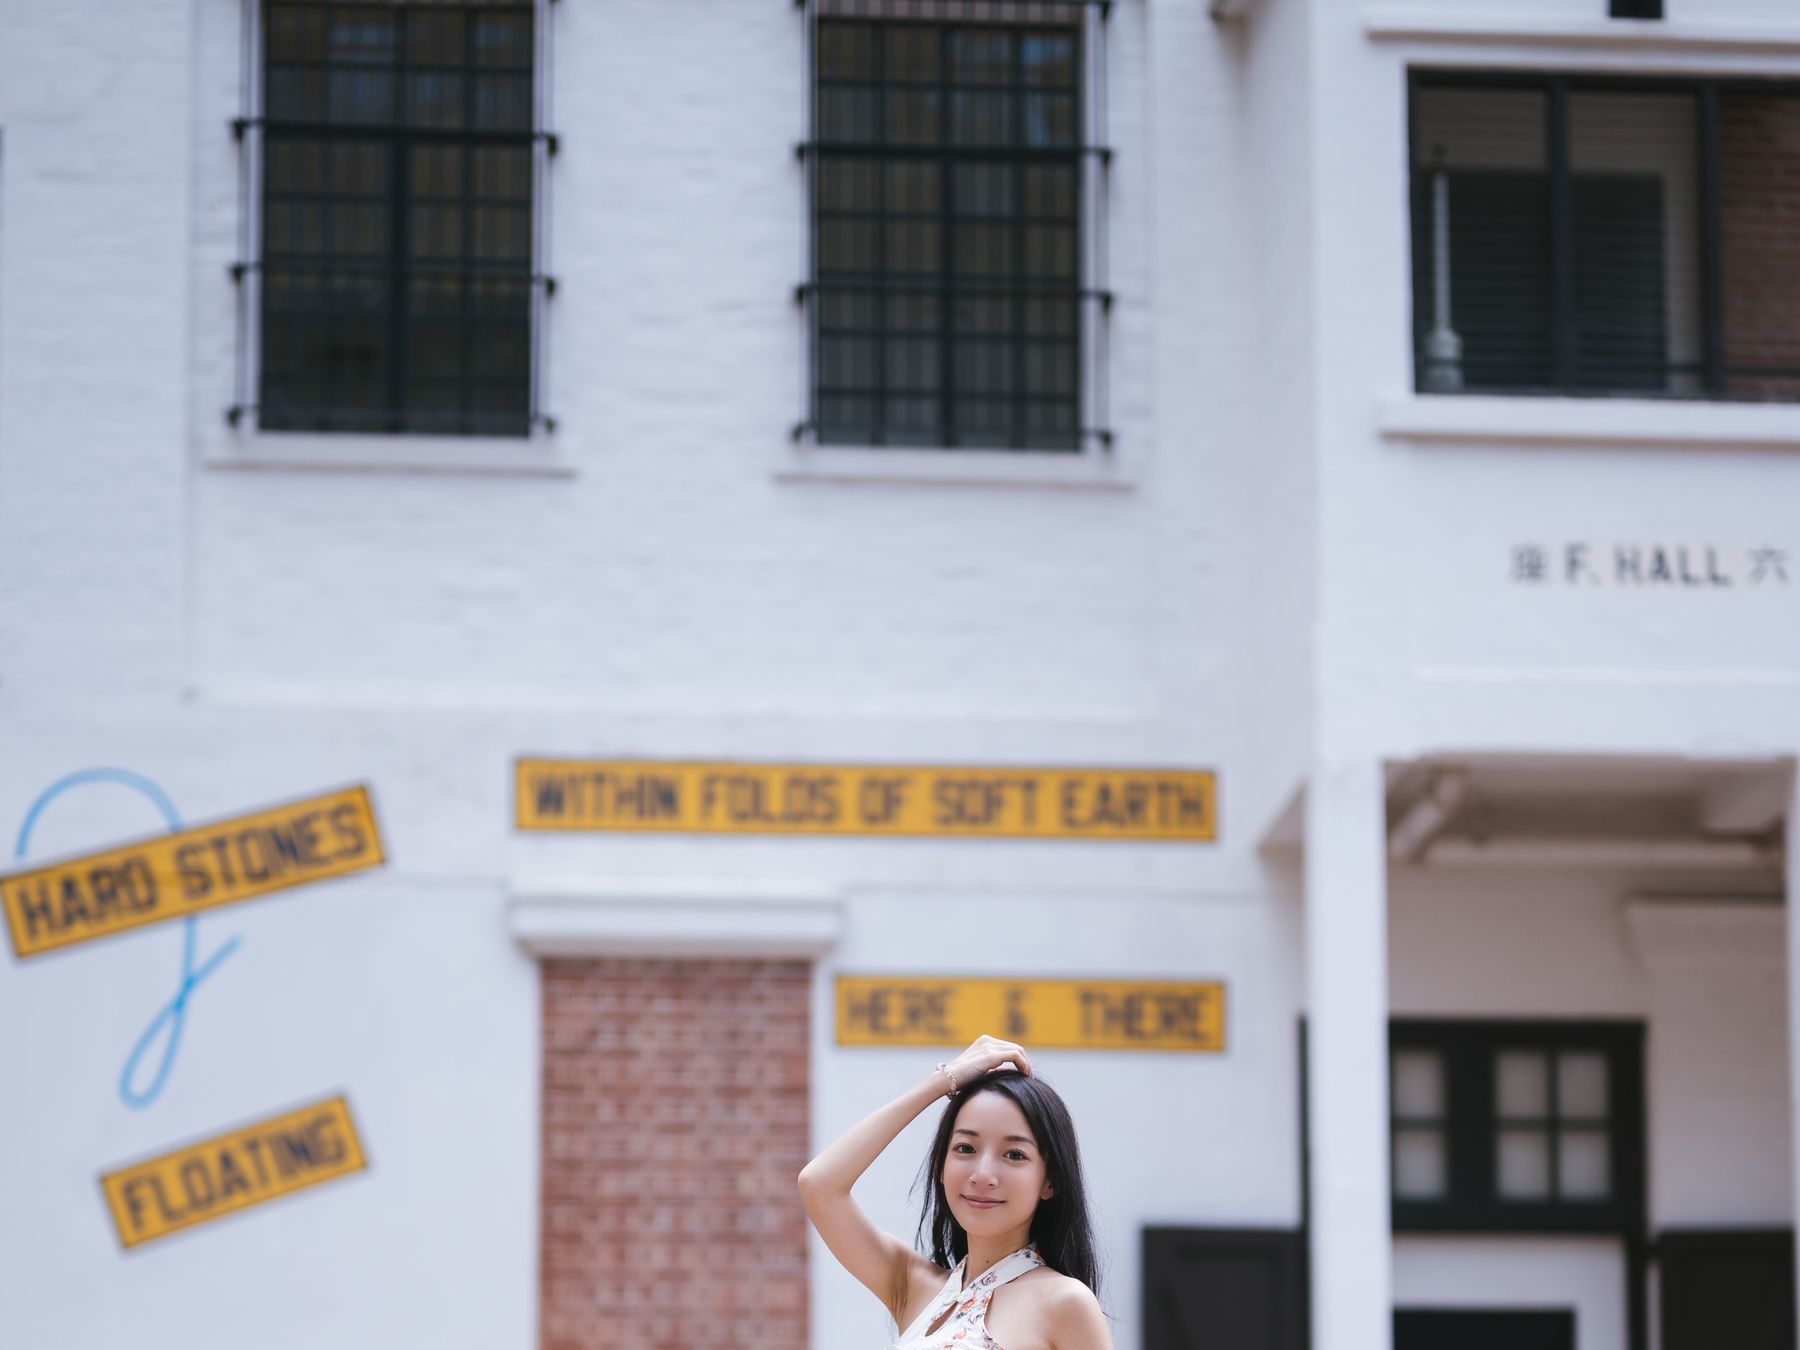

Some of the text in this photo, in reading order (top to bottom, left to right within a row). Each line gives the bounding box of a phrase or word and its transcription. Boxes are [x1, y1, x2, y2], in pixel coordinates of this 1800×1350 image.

[1614, 543, 1733, 587] HALL
[528, 772, 1207, 830] WITHIN FOLDS OF SOFT EARTH
[17, 803, 368, 943] HARD STONES
[845, 985, 956, 1038] HERE
[1078, 989, 1212, 1042] THERE
[120, 1113, 348, 1232] FLOATING
